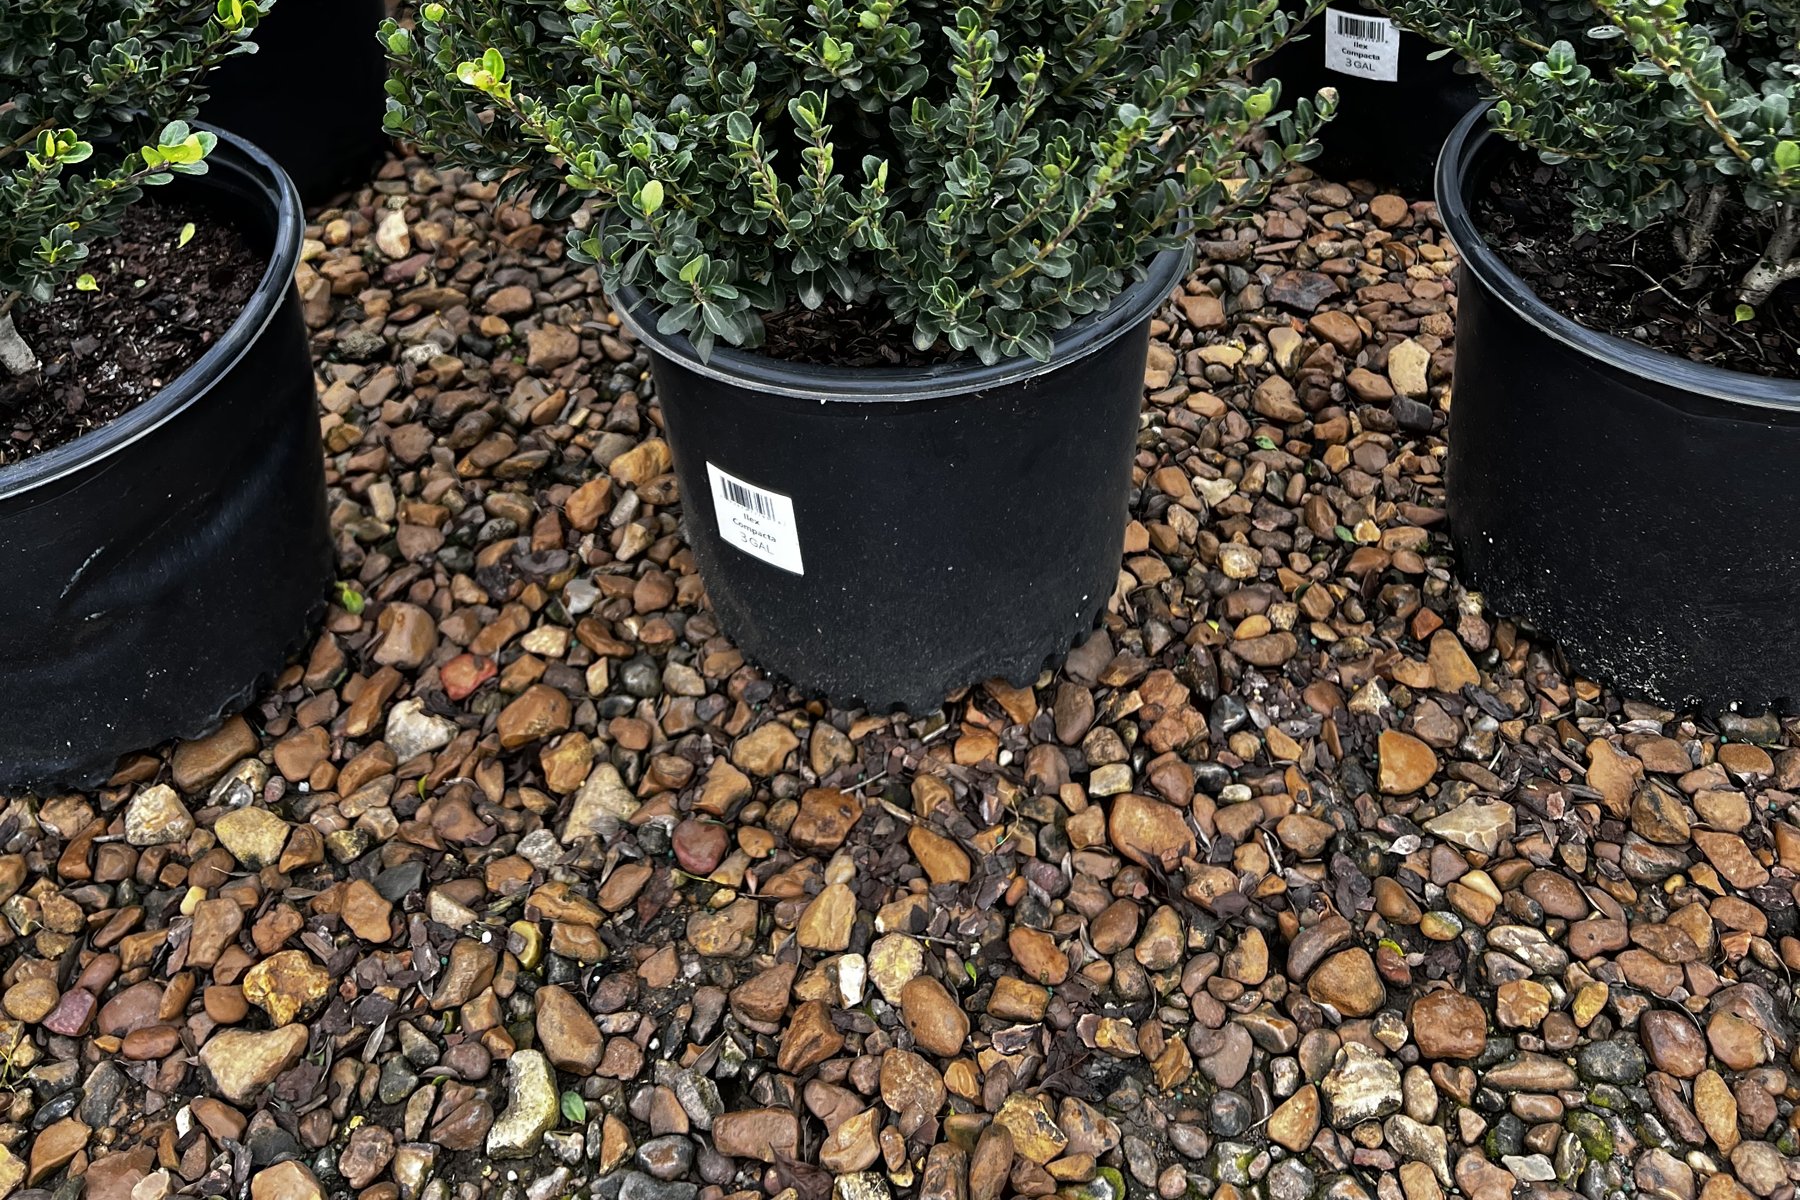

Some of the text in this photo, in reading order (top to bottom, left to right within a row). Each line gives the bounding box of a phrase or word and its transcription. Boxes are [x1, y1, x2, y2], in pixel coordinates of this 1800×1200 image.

[1353, 41, 1368, 49] Ilex
[1341, 47, 1381, 61] Compacta
[1345, 57, 1376, 72] 3 GAL
[743, 513, 761, 526] Ilex
[732, 517, 777, 543] Compacta
[740, 531, 775, 556] 3 GAL
